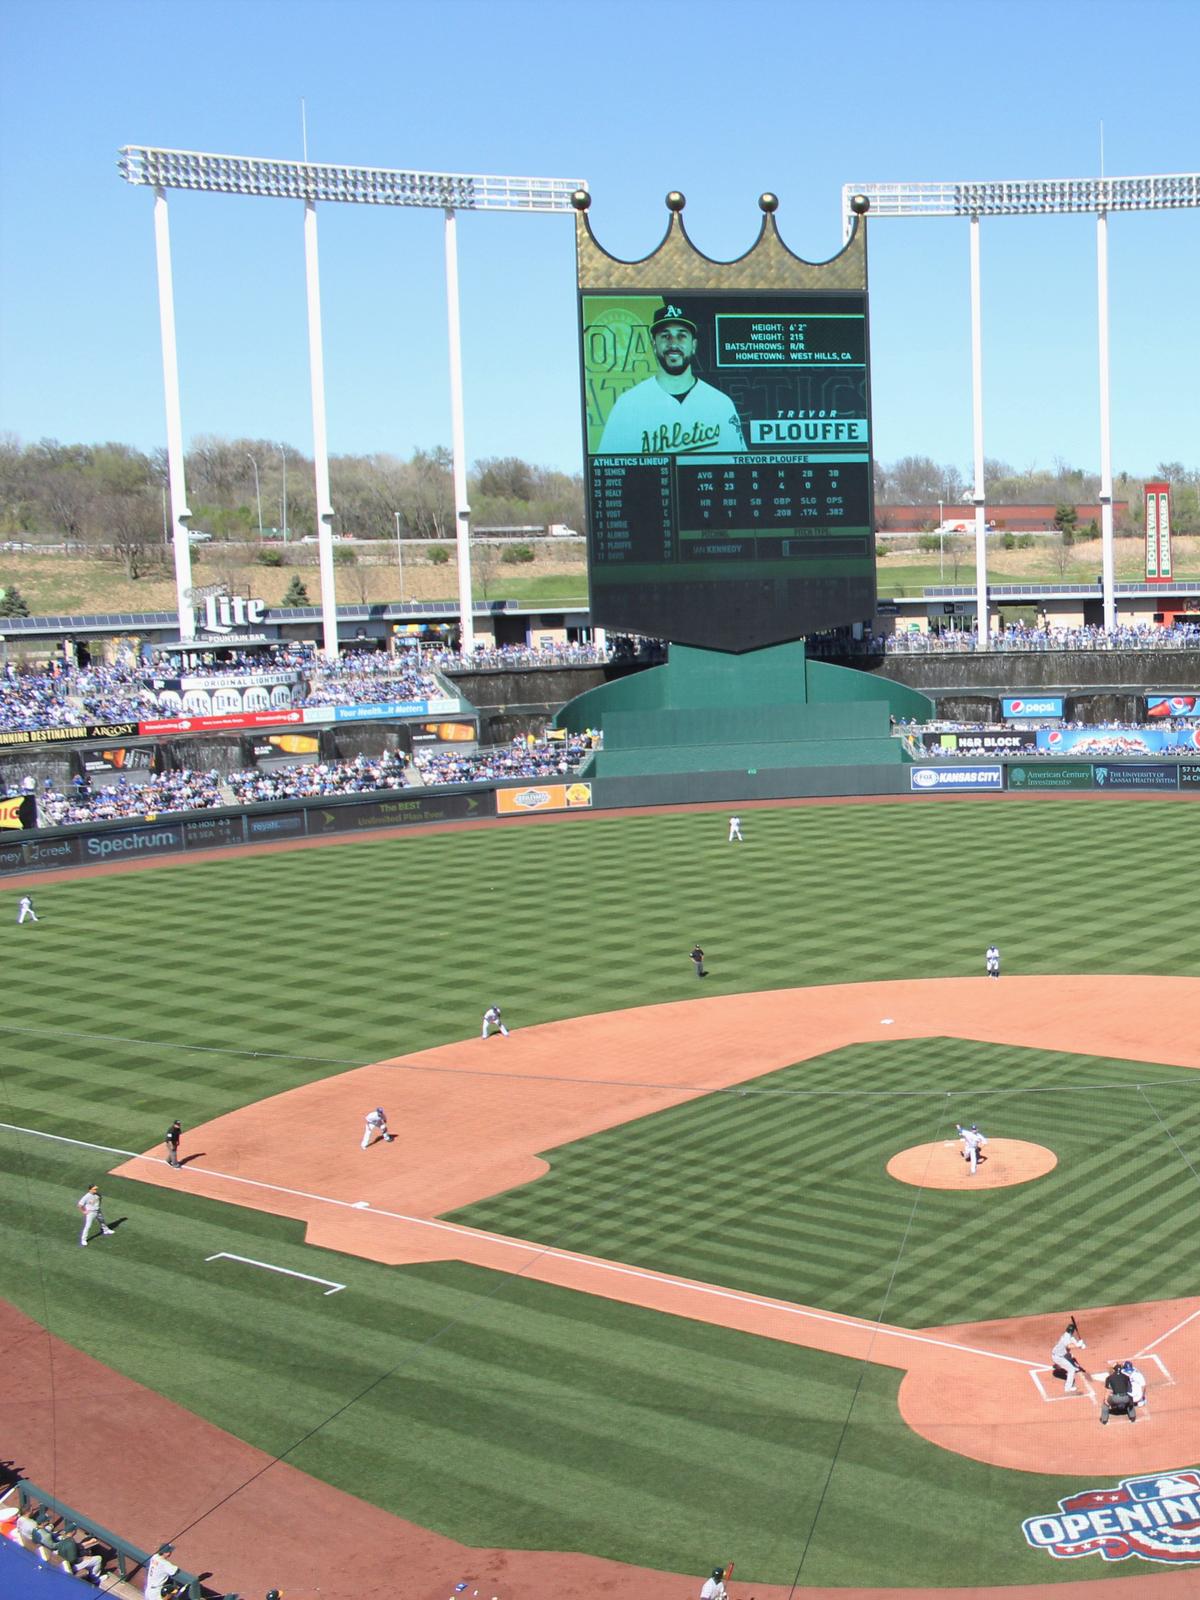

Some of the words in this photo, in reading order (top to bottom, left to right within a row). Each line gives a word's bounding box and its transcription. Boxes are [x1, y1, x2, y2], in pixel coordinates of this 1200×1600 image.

[752, 323, 785, 332] HEIGHT:
[750, 333, 785, 342] WEIGHT:
[790, 333, 804, 342] 215
[725, 342, 785, 352] BATS/THROWS:
[790, 342, 805, 352] R/R
[736, 352, 786, 361] HOMETOWN:
[790, 352, 813, 361] WEST
[814, 352, 840, 361] HILLS,
[841, 352, 852, 361] CA
[776, 410, 838, 419] TREVOR
[759, 422, 859, 441] PLOUFFE
[641, 421, 720, 454] Athletics
[593, 458, 638, 467] ATHLETICS
[639, 457, 669, 466] LINEUP
[733, 456, 768, 464] TREVOR
[769, 455, 809, 464] PLOUFFE
[697, 471, 713, 479] AVG
[723, 471, 735, 479] AB
[778, 470, 784, 478] H
[802, 470, 813, 478] 2B
[697, 483, 714, 491] .174
[724, 483, 734, 491] 23
[752, 482, 758, 490] 0
[779, 482, 785, 490] 4
[805, 481, 811, 489] 0
[831, 481, 837, 489] 0
[773, 497, 791, 505] OBP
[800, 497, 817, 505] SLG
[826, 496, 843, 504] OPS
[727, 510, 732, 518] 1
[800, 508, 818, 516] .174
[1148, 500, 1157, 570] BOULEVARD
[1160, 500, 1170, 570] BOULEVARD
[203, 595, 265, 634] Lite
[249, 633, 267, 641] BAR
[203, 677, 248, 687] ORIGINAL
[275, 674, 292, 683] BEER
[214, 694, 240, 709] Lite
[339, 708, 357, 718] Your
[394, 704, 424, 715] Matters
[1025, 702, 1056, 715] pepsi
[30, 728, 88, 742] DESTINATION!
[92, 725, 134, 737] ARGOSY
[958, 737, 983, 747] H&R
[983, 736, 1020, 747] BLOCK
[939, 772, 975, 783] KANSAS
[1027, 771, 1061, 779] American
[1062, 770, 1089, 780] Century
[1027, 778, 1070, 786] Investments
[379, 803, 397, 813] The
[398, 800, 421, 811] BEST
[197, 820, 216, 829] HOU
[358, 813, 402, 826] Unlimited
[402, 812, 423, 823] Plan
[40, 841, 73, 857] creek
[87, 831, 175, 857] Spectrum
